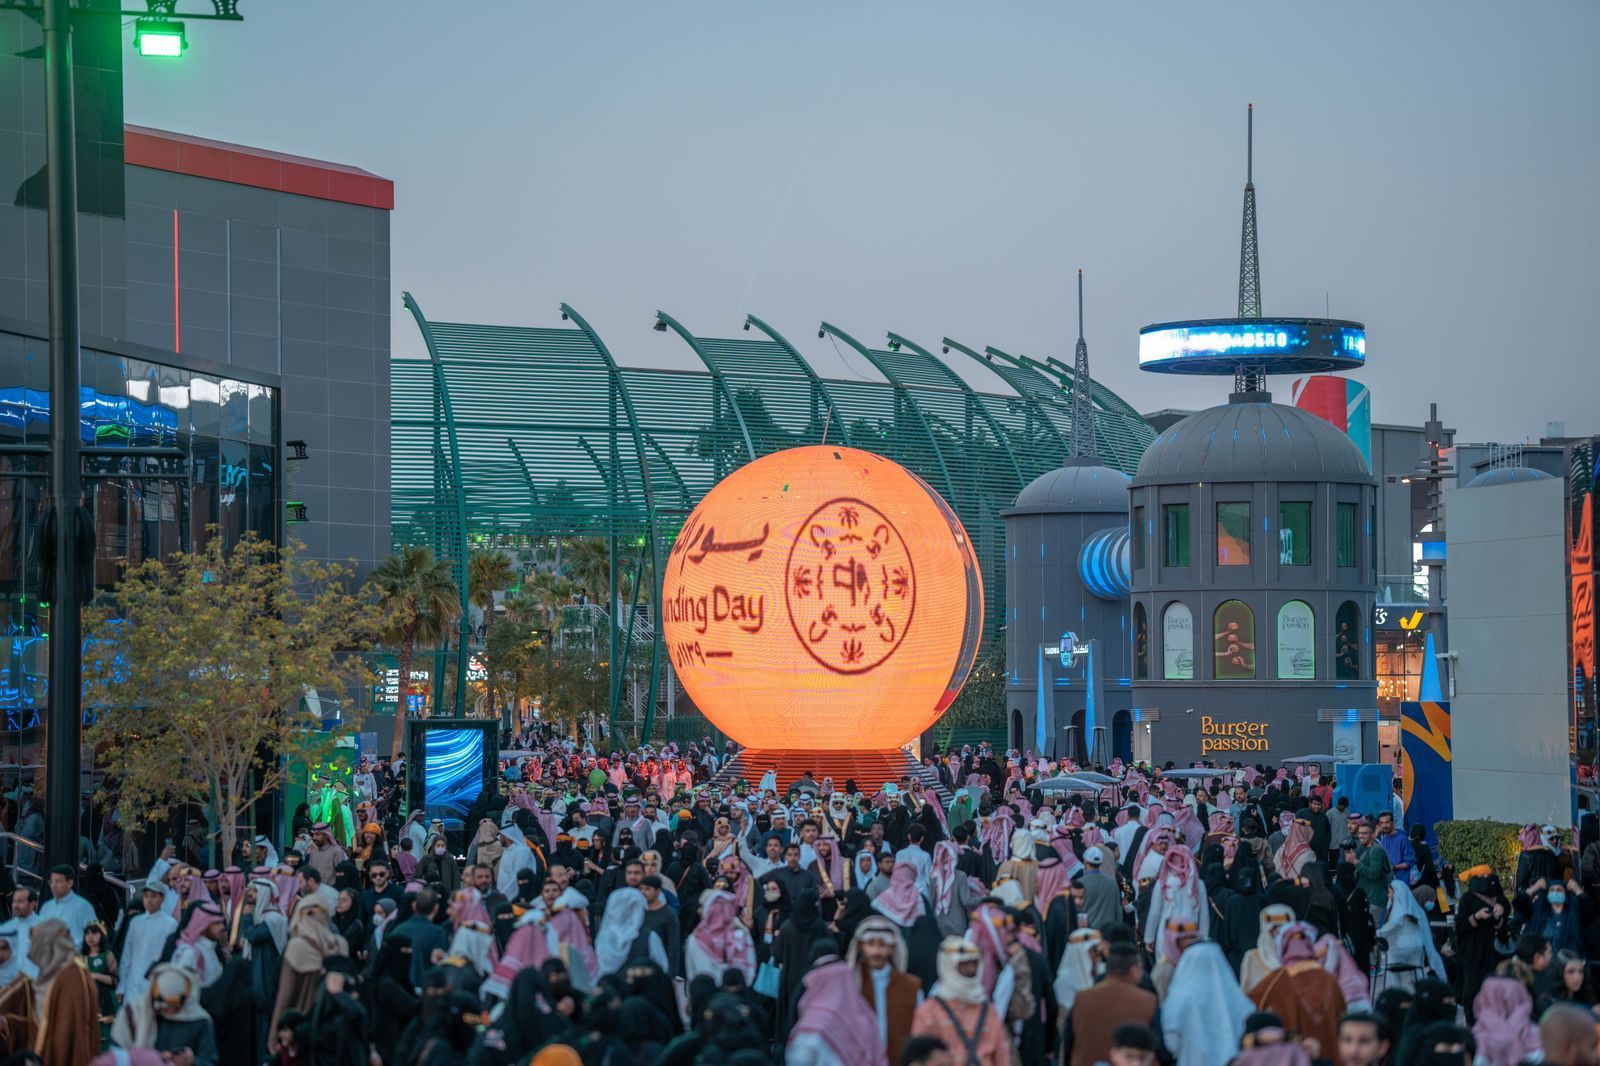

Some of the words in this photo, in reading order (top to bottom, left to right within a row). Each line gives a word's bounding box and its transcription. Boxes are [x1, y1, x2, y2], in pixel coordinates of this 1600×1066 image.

[713, 584, 764, 634] Day
[1201, 715, 1269, 740] Burger
[1201, 737, 1270, 756] passion
